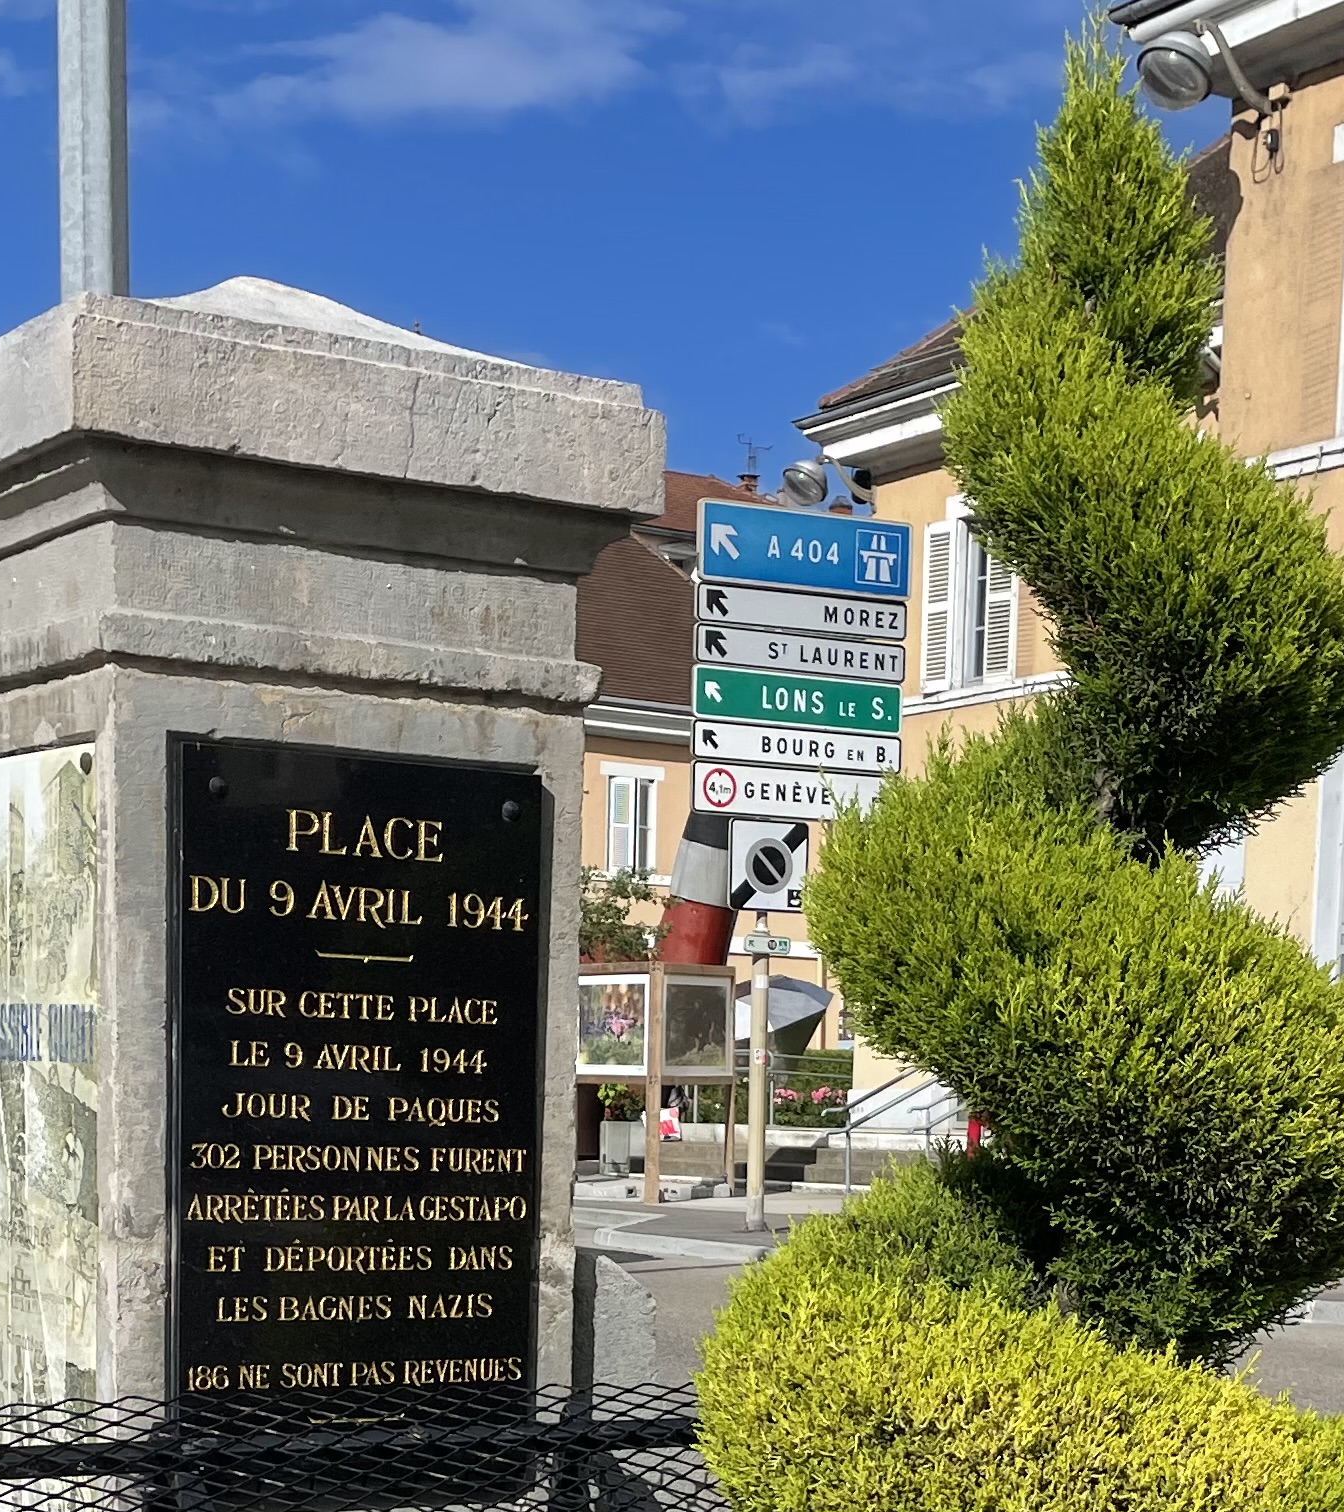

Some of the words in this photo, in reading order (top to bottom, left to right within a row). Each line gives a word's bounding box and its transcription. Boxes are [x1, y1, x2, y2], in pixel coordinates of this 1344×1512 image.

[767, 535, 780, 559] A
[790, 538, 839, 565] 404
[823, 605, 899, 631] MOREZ
[800, 645, 898, 673] LAURENT
[761, 685, 824, 714] LONS
[839, 701, 856, 718] LE
[871, 698, 892, 722] S.
[761, 736, 835, 759] BOURG
[847, 748, 864, 761] EN
[875, 746, 893, 765] B.
[744, 780, 832, 806] GENÈVE
[285, 809, 443, 862] PLACE
[188, 874, 246, 914] DU
[269, 880, 297, 917] 9
[306, 879, 423, 929] AVRIL
[447, 892, 530, 931] 1944
[225, 988, 287, 1018] SUR
[298, 990, 394, 1021] CETTE
[408, 995, 498, 1025] PLACE
[229, 1039, 270, 1068] LE
[285, 1042, 304, 1068] 9
[313, 1043, 402, 1074] AVRIL
[419, 1047, 488, 1074] 1944
[221, 1092, 312, 1122] JOUR
[332, 1096, 370, 1122] DE
[387, 1097, 500, 1127] PAQUES
[190, 1143, 241, 1170] 302
[254, 1144, 420, 1173] PERSONNES
[430, 1147, 527, 1174] FURENT
[332, 1195, 380, 1224] PAR
[384, 1195, 415, 1221] LA
[419, 1195, 528, 1222] GESTAPO
[206, 1245, 246, 1272] ET
[263, 1238, 432, 1275] DÉPORTÉES
[448, 1245, 514, 1271] DANS
[215, 1296, 268, 1322] LES
[277, 1295, 392, 1322] BAGNES
[408, 1293, 493, 1320] NAZIS
[186, 1365, 230, 1391] 186
[238, 1364, 270, 1390] NE
[279, 1362, 343, 1388] SONT
[350, 1360, 395, 1386] PAS
[403, 1357, 522, 1387] REVENUES
